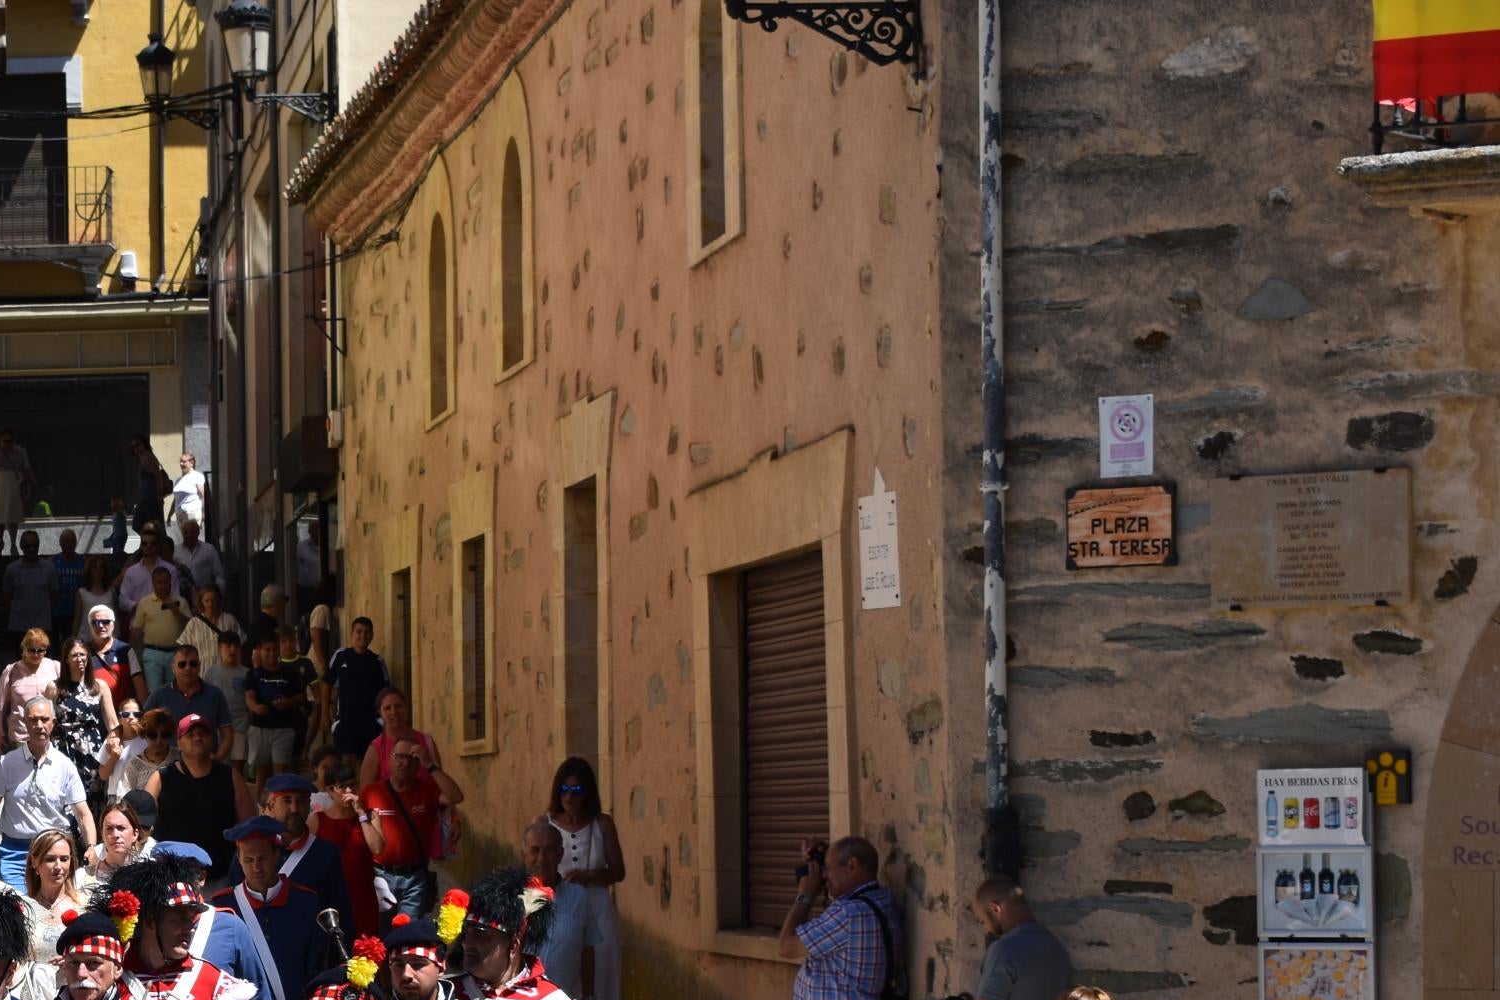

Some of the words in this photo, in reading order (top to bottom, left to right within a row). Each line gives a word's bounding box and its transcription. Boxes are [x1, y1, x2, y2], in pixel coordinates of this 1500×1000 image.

[1091, 516, 1149, 535] PLAZA
[1068, 541, 1104, 558] STA.
[1109, 538, 1171, 557] TERESA
[1264, 778, 1285, 787] HAY
[1287, 777, 1330, 787] BEBIDAS
[1331, 775, 1359, 786] FRÍAS
[1453, 846, 1500, 865] Rec
